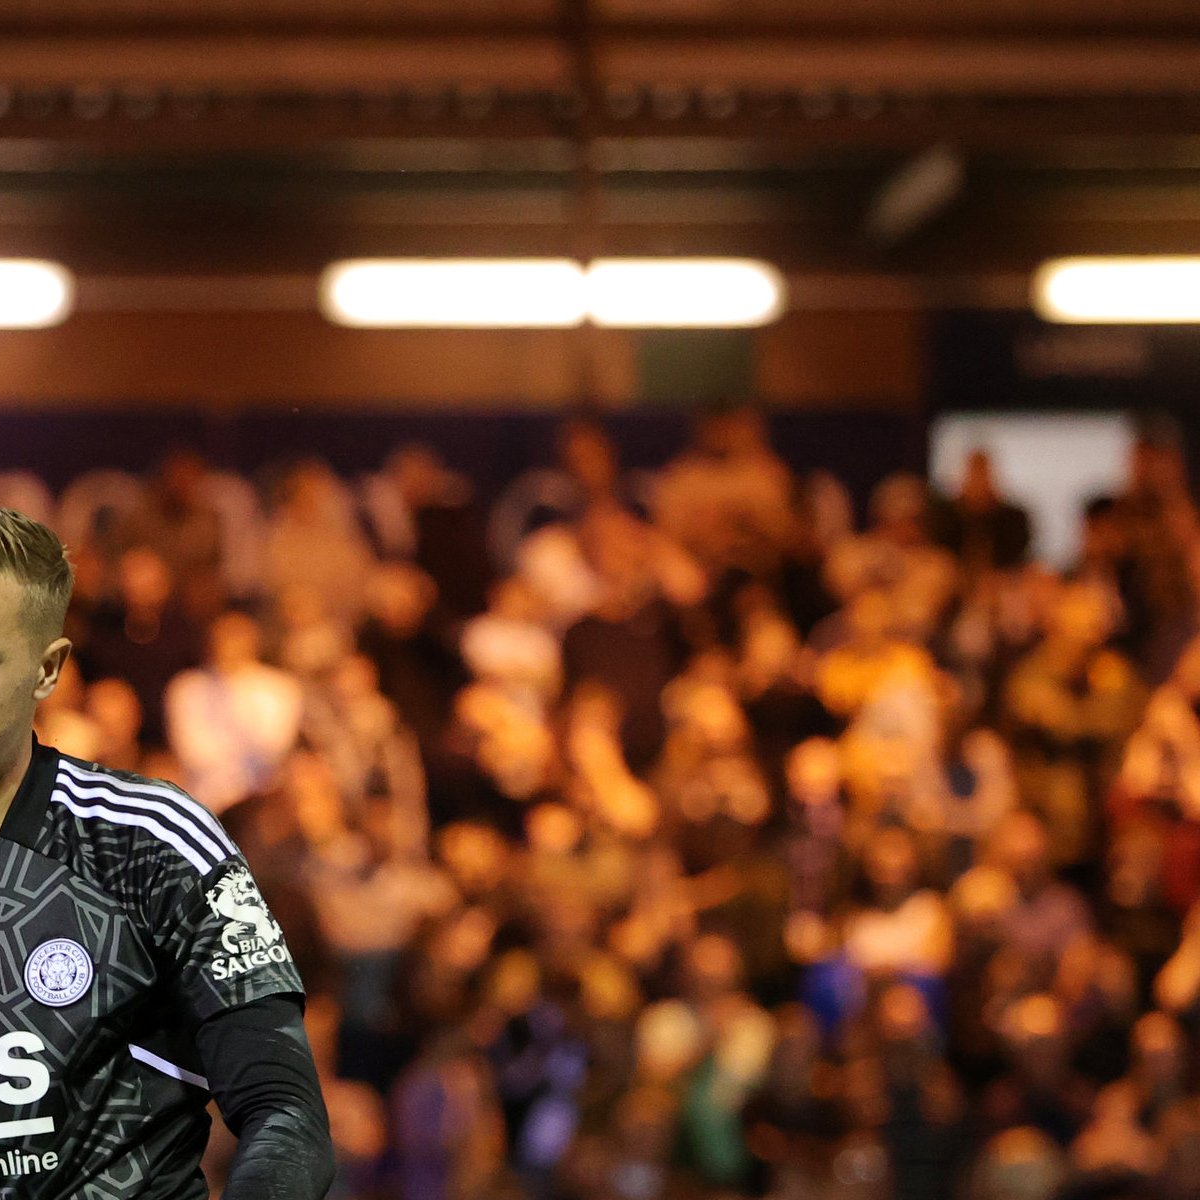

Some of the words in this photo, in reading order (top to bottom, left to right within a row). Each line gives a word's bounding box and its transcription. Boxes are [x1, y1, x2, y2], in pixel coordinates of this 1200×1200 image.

[32, 944, 71, 971] LEICESTER
[72, 949, 86, 968] CITY
[239, 937, 268, 954] BIA
[211, 945, 293, 980] SAIGO
[32, 976, 69, 1000] FOOTBALL
[69, 973, 86, 995] CLUB
